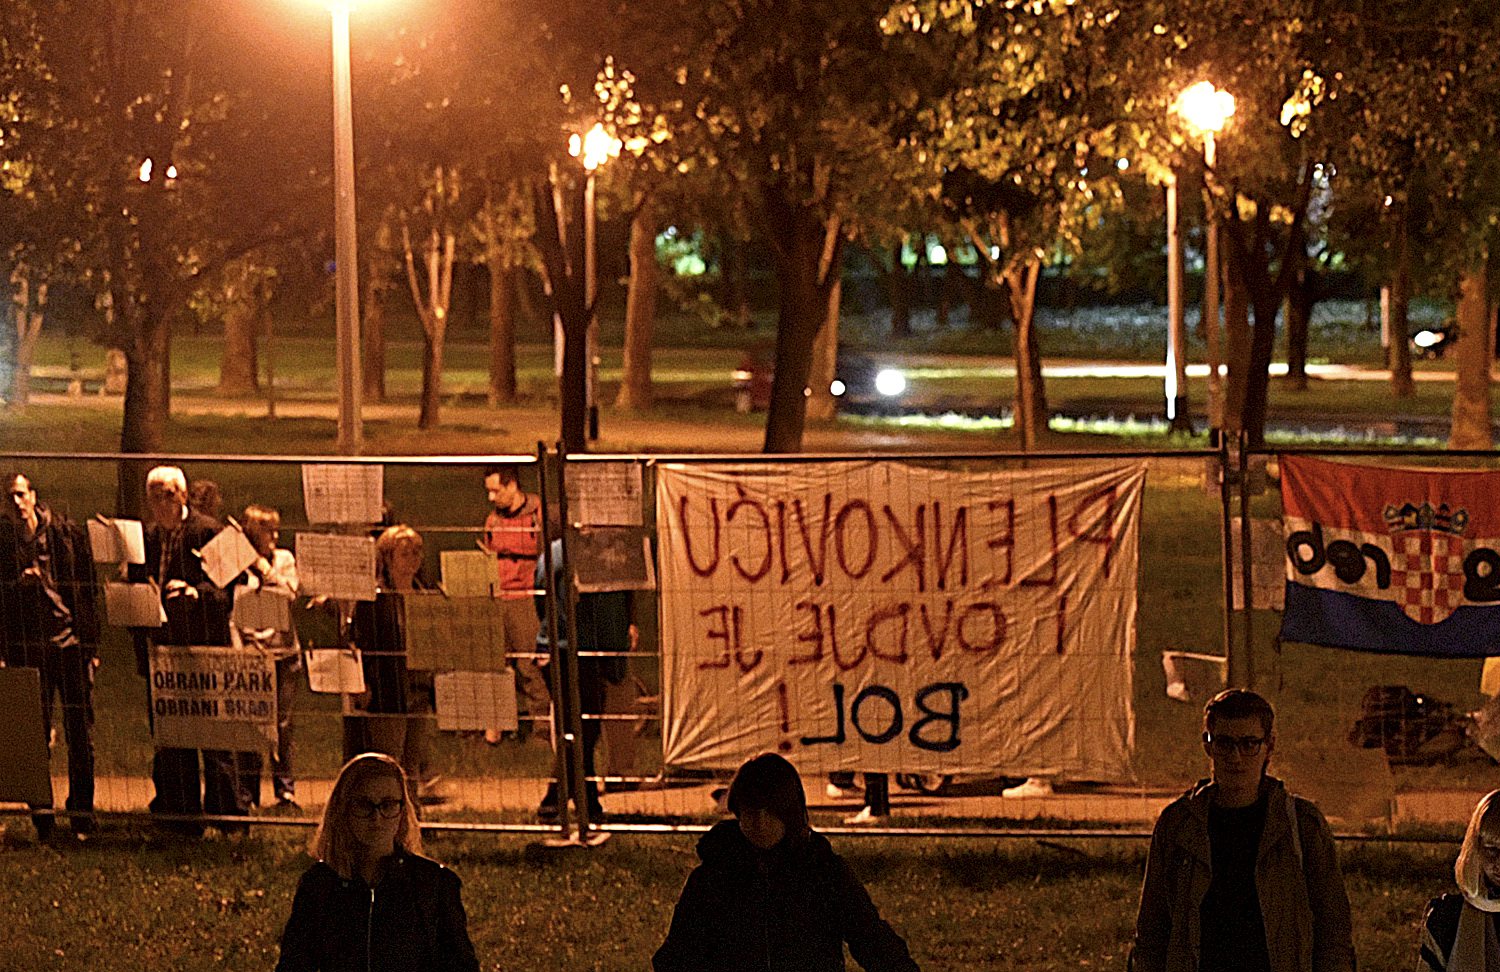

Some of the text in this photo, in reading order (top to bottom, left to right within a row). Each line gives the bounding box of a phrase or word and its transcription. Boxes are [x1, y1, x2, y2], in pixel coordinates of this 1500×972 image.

[153, 670, 273, 692] OBRANI PARK
[155, 698, 219, 717] OBRANI
